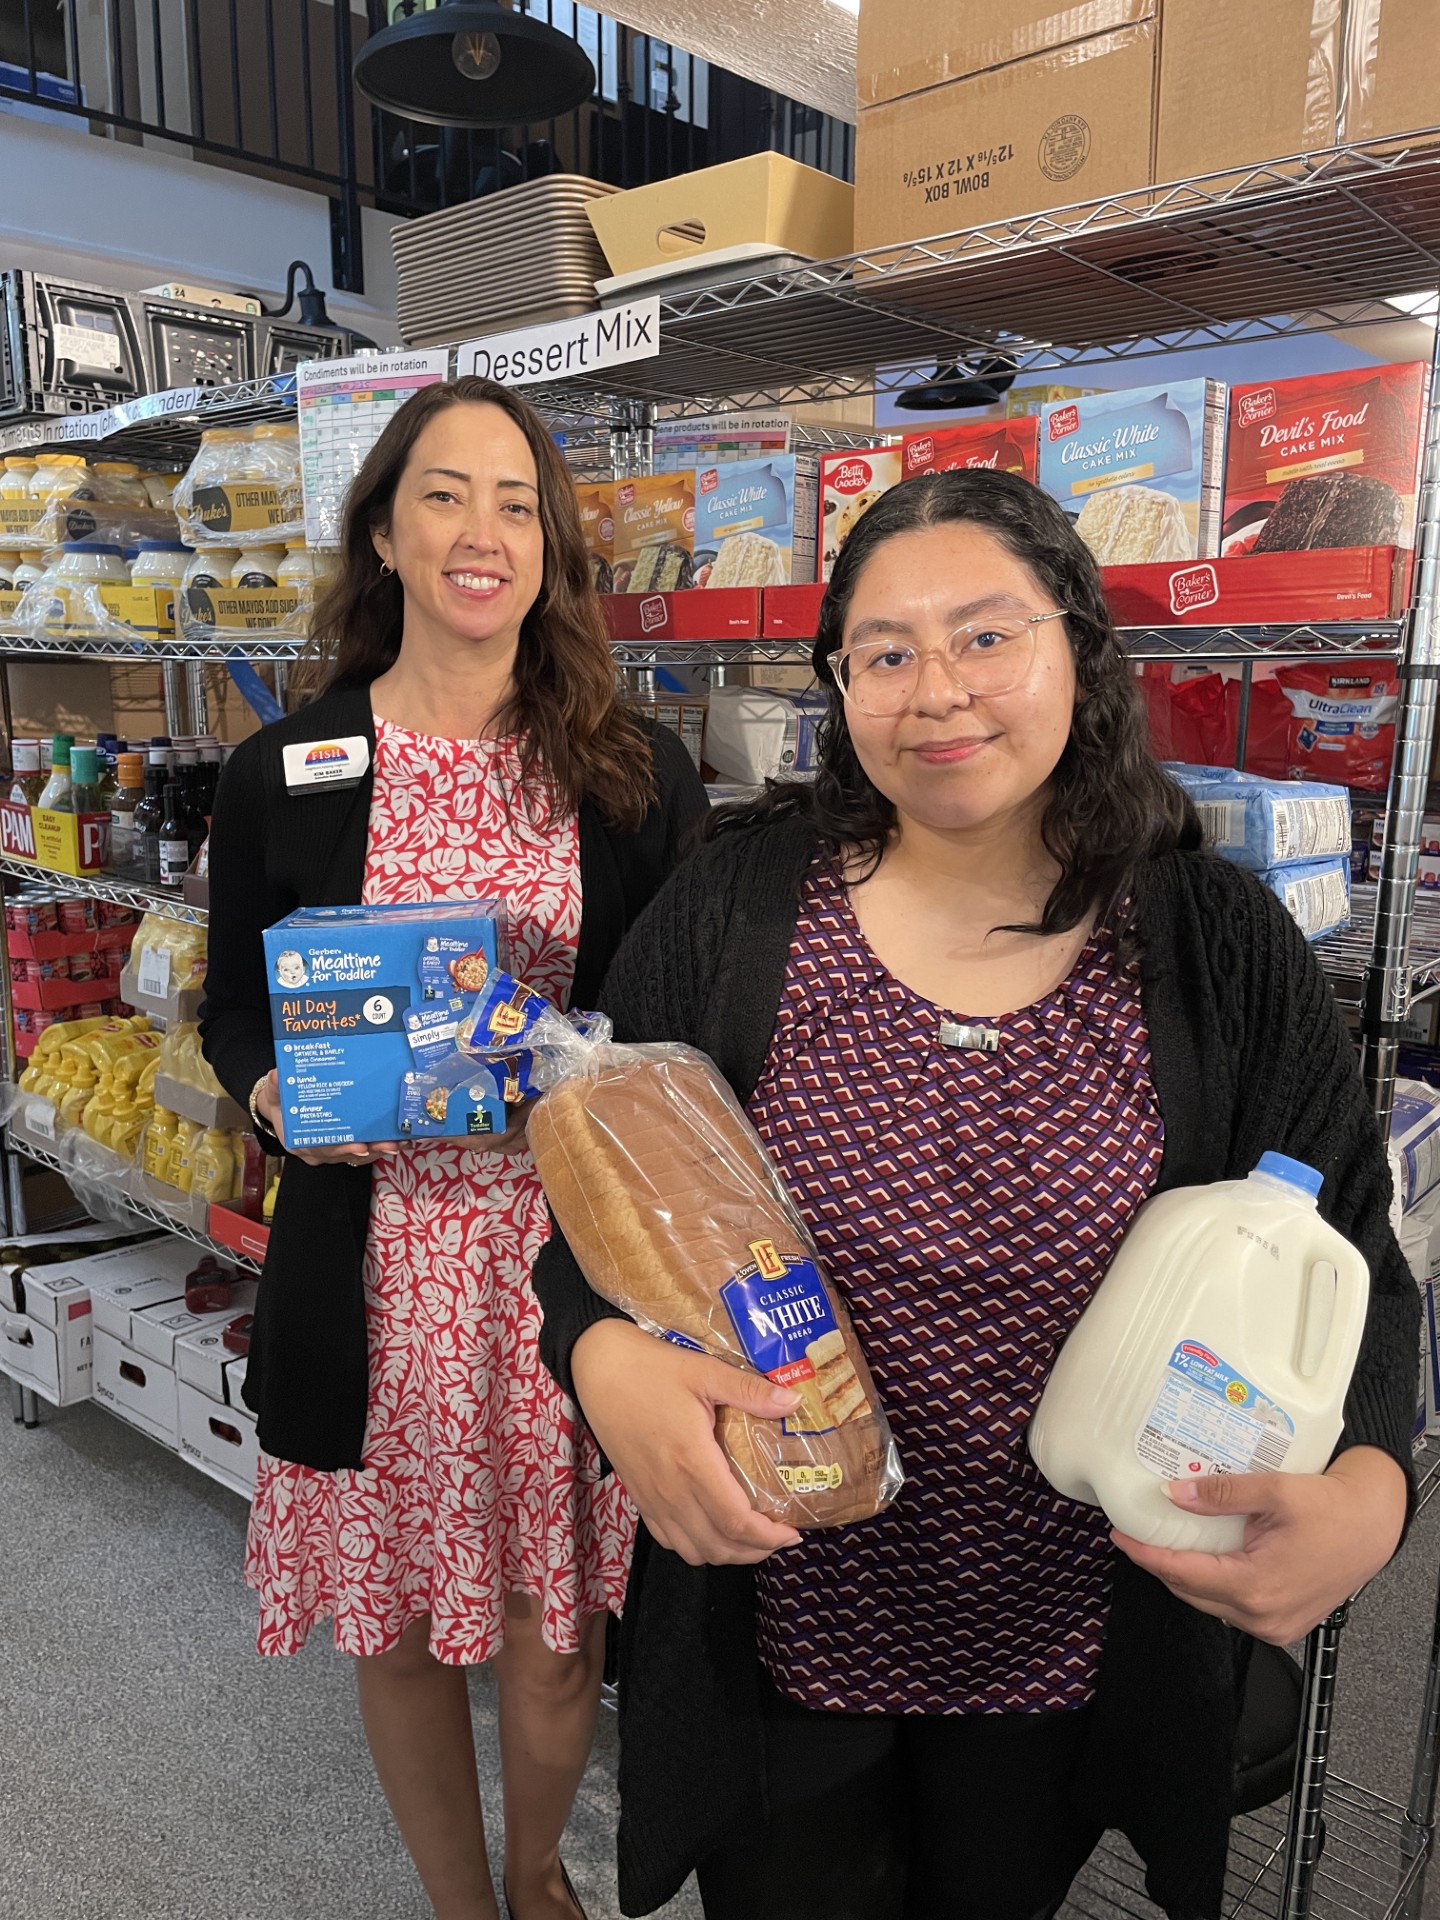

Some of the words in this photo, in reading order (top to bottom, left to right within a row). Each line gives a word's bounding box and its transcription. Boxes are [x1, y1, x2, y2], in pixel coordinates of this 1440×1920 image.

[935, 162, 945, 179] X
[947, 158, 962, 176] 12
[966, 154, 976, 171] X
[953, 171, 990, 195] BOWL
[924, 182, 950, 204] BOX
[473, 332, 589, 382] Dessert
[596, 308, 652, 357] Mix
[303, 367, 348, 382] Condiments
[349, 363, 365, 376] will
[366, 362, 378, 374] be
[380, 361, 389, 372] in
[390, 358, 428, 371] rotation
[1242, 392, 1273, 411] Baker's
[54, 420, 98, 440] rotation
[99, 407, 132, 435] (chek
[1050, 408, 1076, 426] Baker's
[1242, 407, 1273, 426] Corner
[1260, 416, 1316, 448] Devil's
[1318, 402, 1370, 438] Food
[673, 422, 710, 435] products
[711, 420, 727, 430] will
[728, 420, 740, 430] be
[741, 419, 750, 429] in
[751, 418, 789, 428] rotation
[1050, 422, 1077, 440] Corner
[1061, 436, 1112, 465] Classic
[1112, 423, 1160, 449] White
[1280, 440, 1316, 457] CAKE
[1320, 433, 1345, 448] MIX
[1082, 455, 1112, 470] CAKE
[1116, 448, 1137, 462] MIX
[834, 472, 869, 488] Crocker
[838, 464, 865, 479] Betty
[235, 491, 260, 508] OTHER
[707, 493, 738, 514] Classic
[738, 485, 768, 505] White
[268, 508, 281, 524] WE
[623, 505, 652, 524] Classic
[653, 496, 684, 519] Yellow
[719, 509, 738, 519] CAKE
[740, 504, 753, 513] MIX
[636, 521, 654, 531] CAKE
[655, 517, 668, 526] MIX
[1174, 571, 1211, 592] Baker's
[1175, 588, 1212, 609] Corner
[1336, 592, 1356, 600] Devil's
[1356, 591, 1372, 600] Food
[218, 600, 238, 614] OTHER
[239, 600, 264, 614] MAYOS
[265, 600, 279, 613] ADD
[245, 617, 257, 629] WE
[257, 617, 277, 629] DON'T
[1331, 677, 1370, 686] KIRKLAND
[1308, 698, 1373, 715] UltraClean
[312, 748, 341, 761] FISH
[325, 768, 343, 776] BAKER
[0, 808, 35, 856] PAM
[308, 947, 340, 956] Gerber
[311, 952, 382, 972] Mealtime
[311, 970, 332, 984] for
[333, 968, 377, 983] Toddler
[282, 999, 301, 1016] All
[305, 999, 337, 1016] Day
[373, 999, 383, 1012] 6
[371, 1012, 387, 1020] COUNT
[293, 1041, 331, 1051] breakfast
[411, 1030, 441, 1045] simply
[296, 1075, 317, 1083] lunch
[737, 1263, 757, 1278] L'OVEN
[759, 1284, 806, 1306] CLASSIC
[748, 1295, 826, 1338] WHITE
[787, 1327, 813, 1341] BREAD
[1174, 1351, 1191, 1368] 1%
[1190, 1359, 1205, 1370] LOW
[1203, 1366, 1216, 1375] FAT
[1214, 1371, 1230, 1383] MILK
